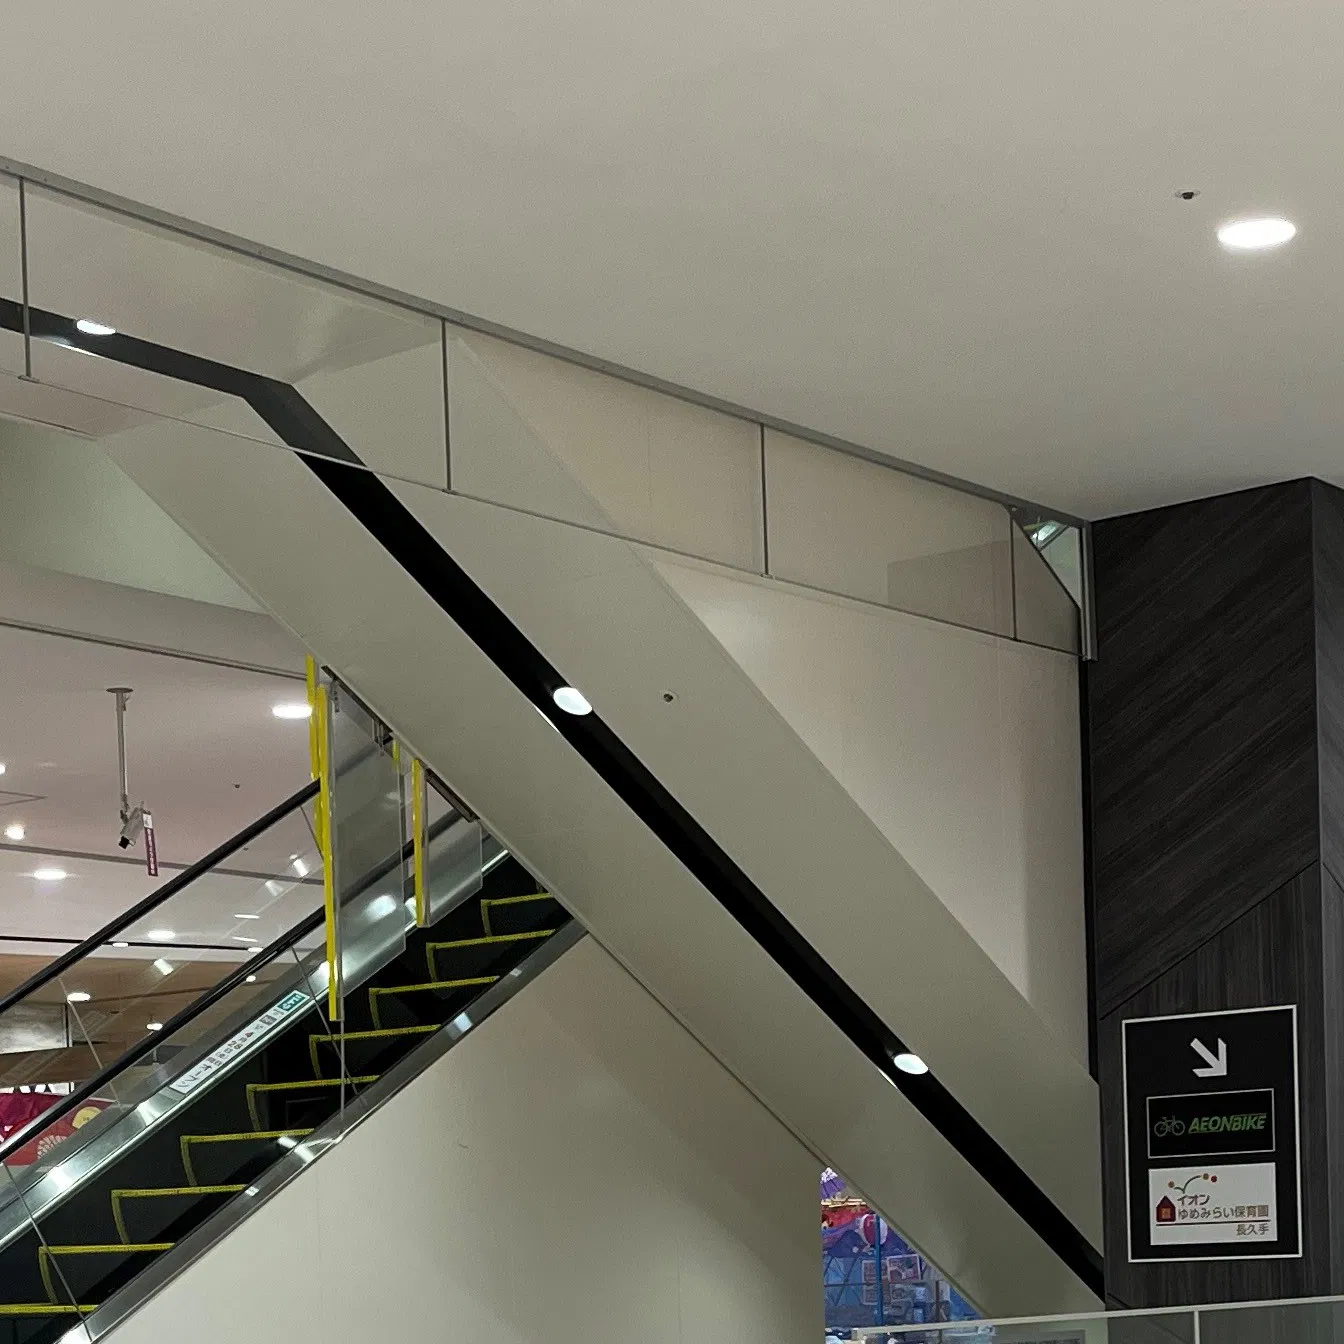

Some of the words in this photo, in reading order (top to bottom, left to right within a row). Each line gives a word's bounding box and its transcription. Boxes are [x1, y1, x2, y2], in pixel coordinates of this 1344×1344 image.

[1188, 1113, 1267, 1134] AEONBIKE
[1177, 1194, 1211, 1206] イオン
[1177, 1204, 1269, 1220] ゆめみらい保育園
[1236, 1224, 1270, 1236] 長久手
